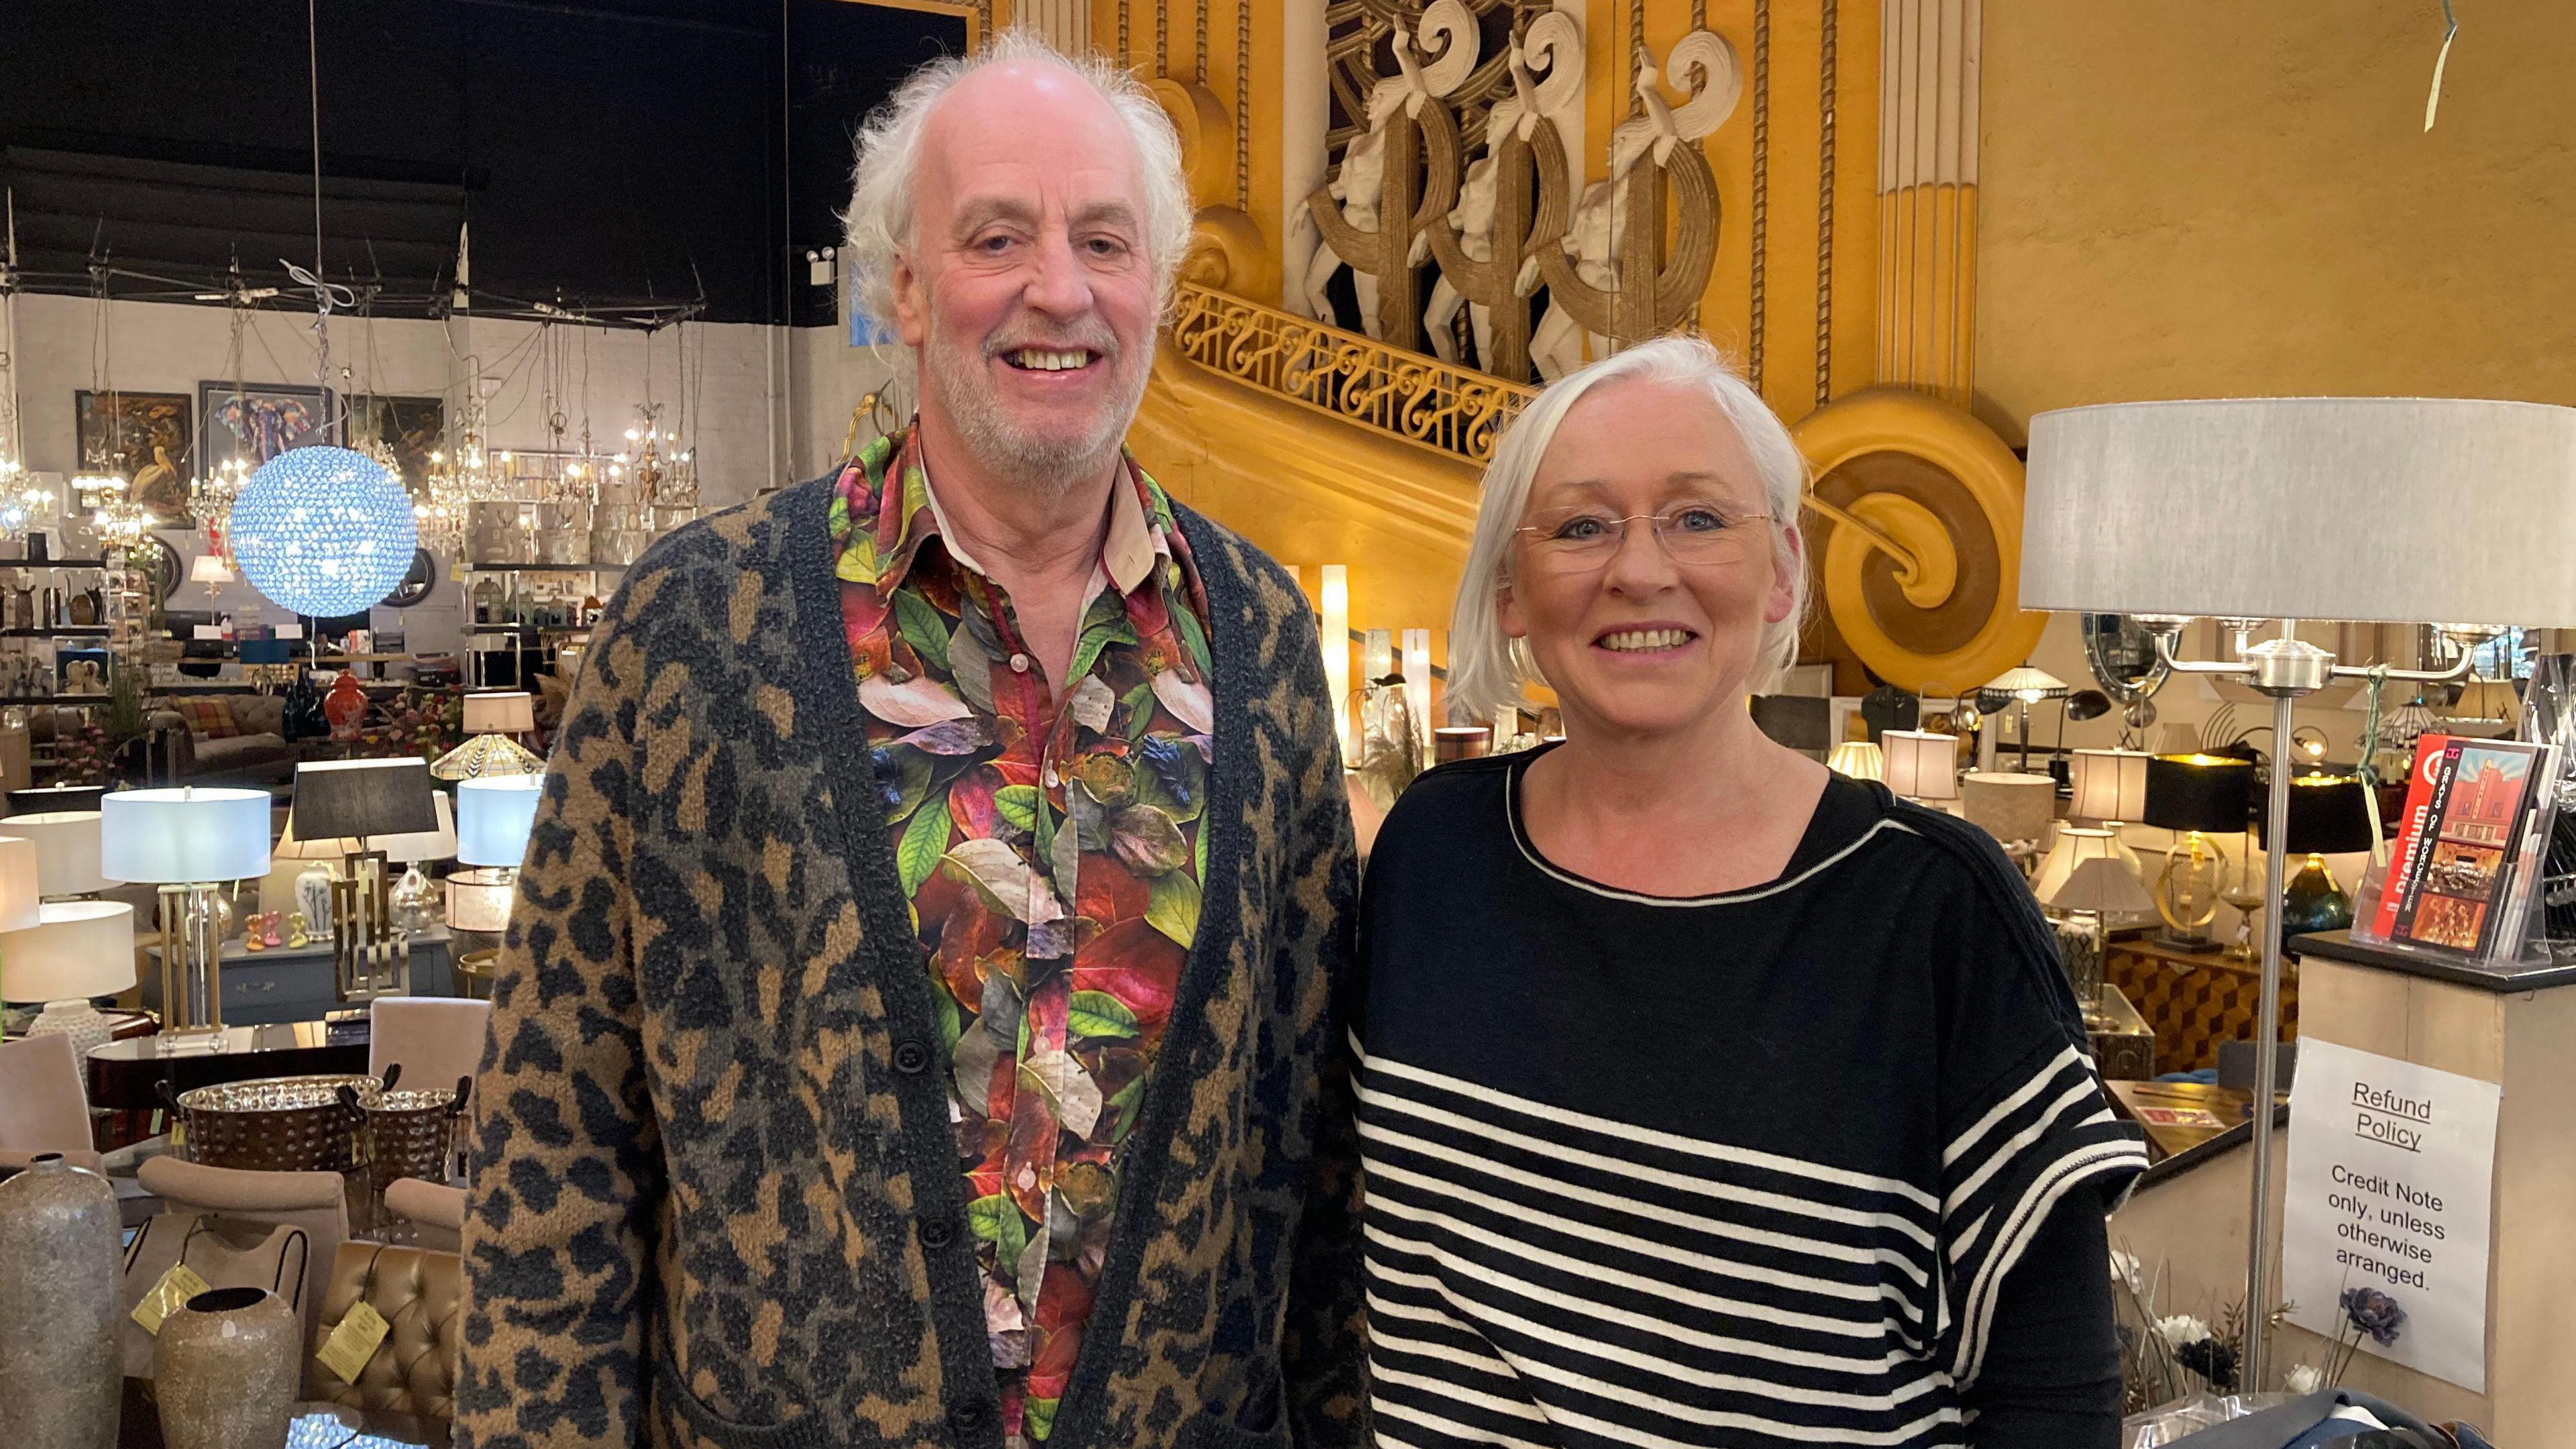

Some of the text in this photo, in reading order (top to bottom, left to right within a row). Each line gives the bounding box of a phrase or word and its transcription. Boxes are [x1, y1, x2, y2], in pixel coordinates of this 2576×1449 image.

[2434, 766, 2451, 809] GRAYS
[2428, 814, 2438, 831] OF
[2395, 804, 2429, 895] premium
[2405, 837, 2432, 913] WORCESTER
[2354, 1082, 2430, 1119] Refund
[2357, 1113, 2421, 1151] Policy
[2331, 1165, 2443, 1212] Credit Note
[2328, 1193, 2445, 1240] only, unless
[2337, 1223, 2432, 1264] otherwise
[2336, 1249, 2430, 1291] arranged.
